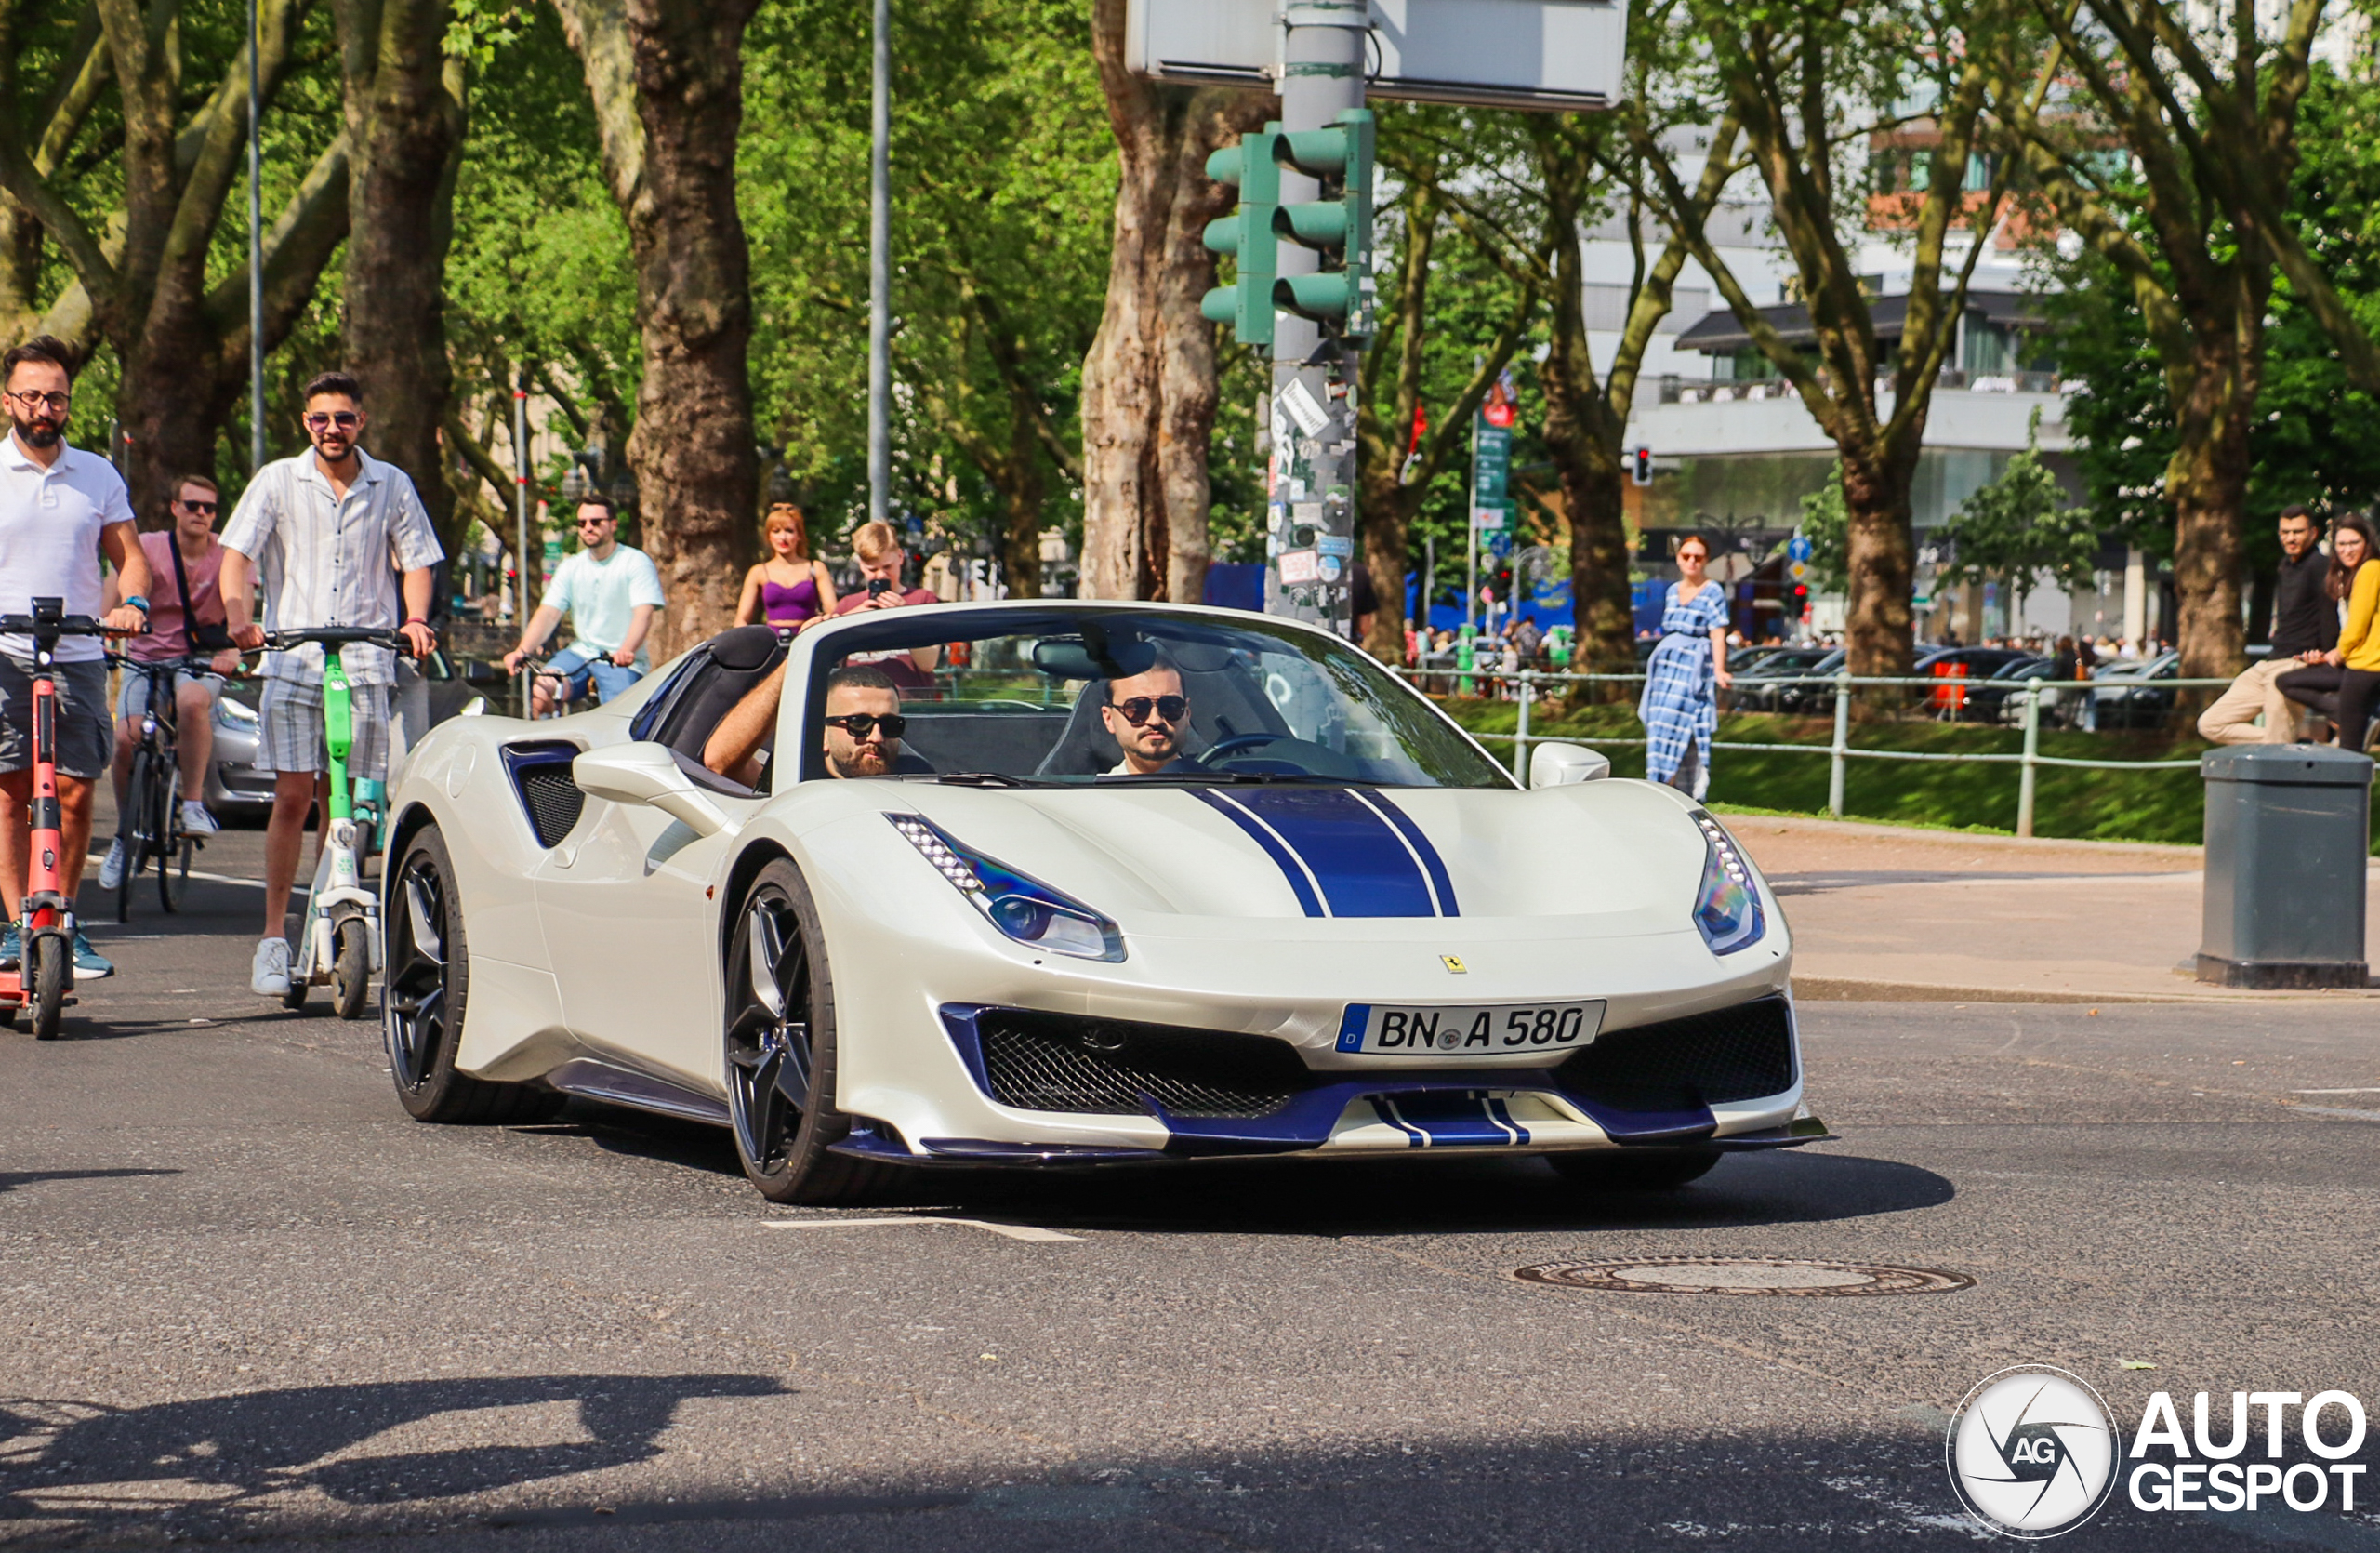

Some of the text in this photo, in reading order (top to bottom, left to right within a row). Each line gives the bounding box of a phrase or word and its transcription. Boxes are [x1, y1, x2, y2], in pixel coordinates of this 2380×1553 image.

[1345, 1033, 1356, 1044] D
[1378, 1007, 1584, 1048] BN A 580
